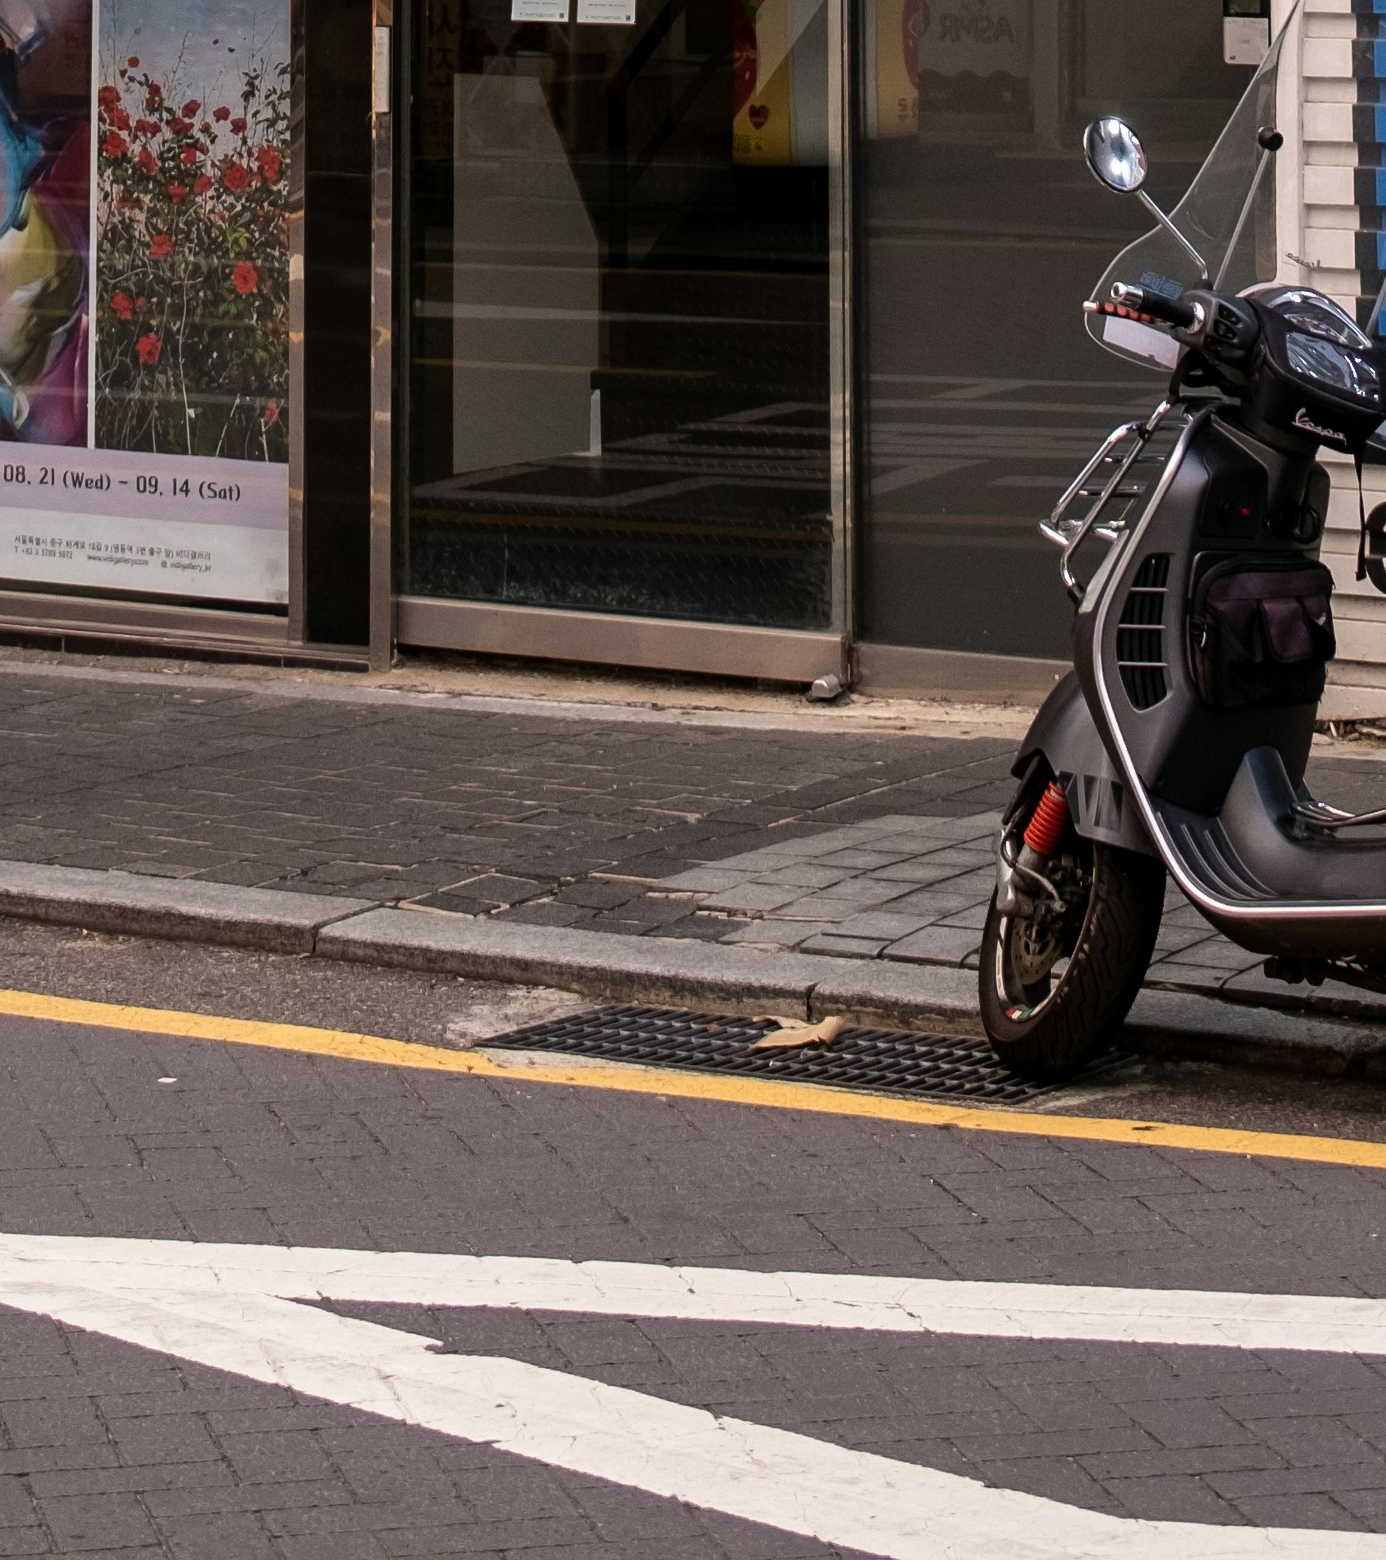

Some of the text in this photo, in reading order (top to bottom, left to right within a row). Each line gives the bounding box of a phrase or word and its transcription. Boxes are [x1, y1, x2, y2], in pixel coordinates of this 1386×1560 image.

[3, 463, 31, 486] 08.
[39, 467, 55, 486] 21
[62, 469, 111, 491] (Wed)
[136, 476, 164, 498] 09.
[172, 478, 190, 498] 14
[198, 481, 242, 502] (Sat)
